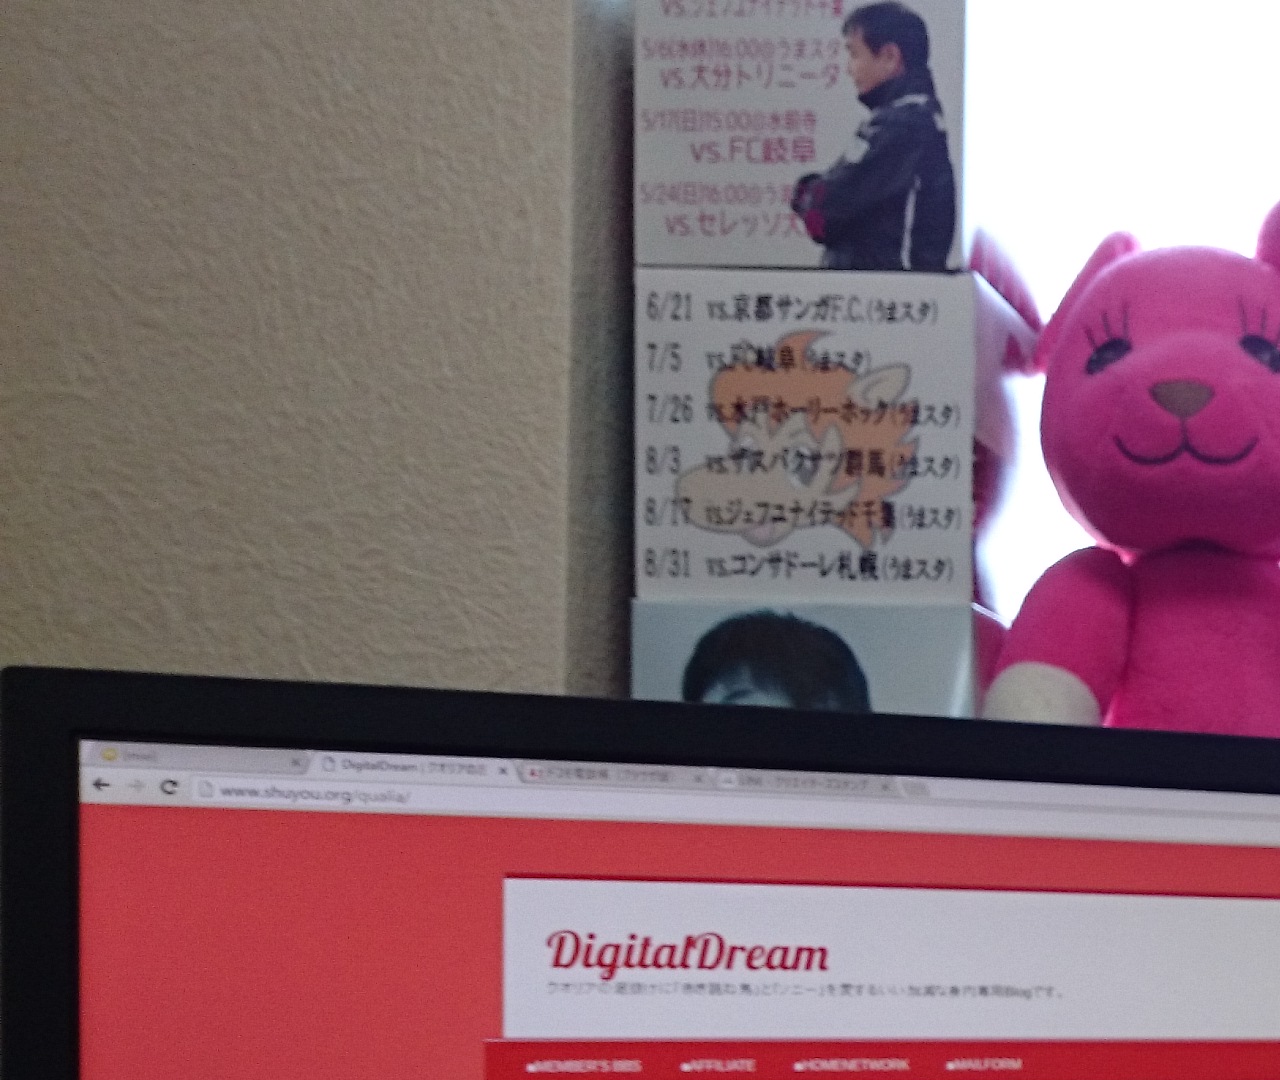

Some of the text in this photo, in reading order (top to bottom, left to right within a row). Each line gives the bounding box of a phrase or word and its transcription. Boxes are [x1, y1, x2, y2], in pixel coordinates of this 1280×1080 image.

[646, 292, 693, 322] 6/21
[646, 342, 682, 373] 7/5
[646, 394, 694, 425] 7/26
[645, 444, 681, 475] 8/3
[645, 496, 692, 527] 8/17
[644, 547, 691, 579] 8/31
[545, 928, 830, 982] DigitalDream
